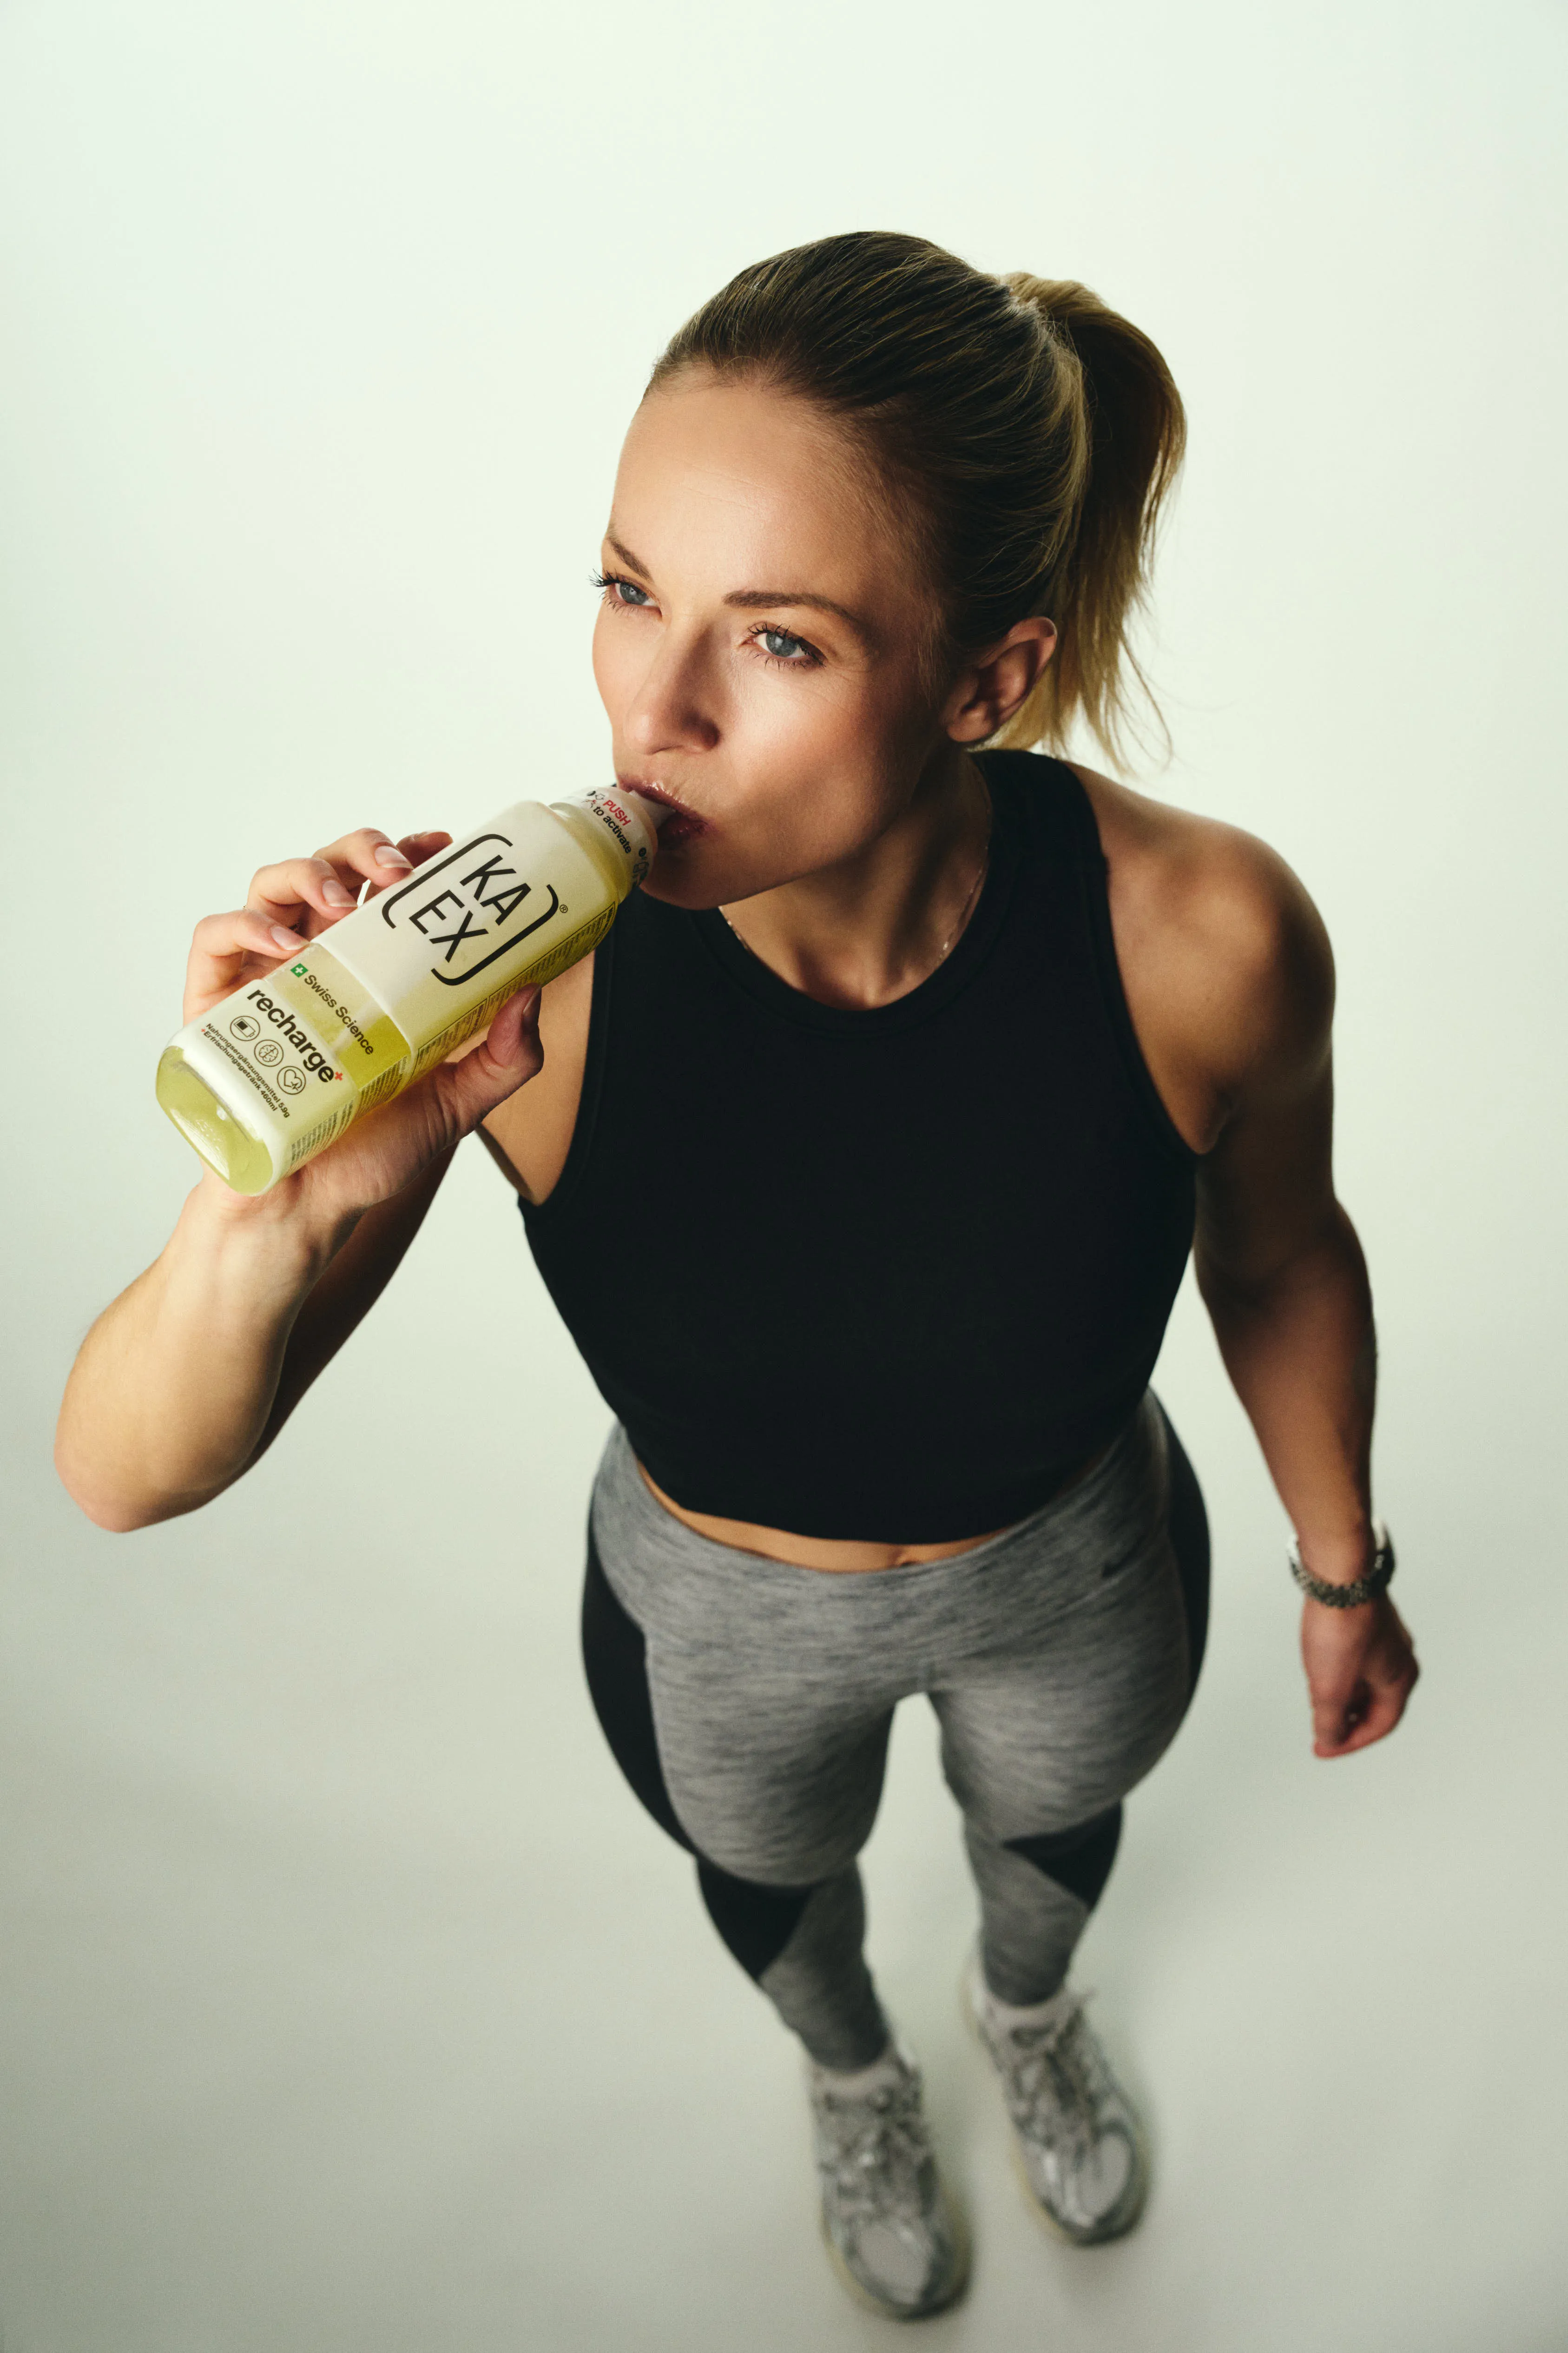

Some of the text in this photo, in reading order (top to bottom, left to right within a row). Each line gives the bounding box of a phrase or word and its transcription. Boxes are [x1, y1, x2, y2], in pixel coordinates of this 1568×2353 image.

[593, 806, 632, 854] to activate
[603, 800, 631, 826] PUSH
[459, 854, 531, 925] KA
[408, 889, 489, 963] EX
[304, 975, 374, 1055] Swiss Science
[206, 1023, 281, 1104] Nahrungsergänzungsmittel
[261, 1090, 278, 1111] 460ml
